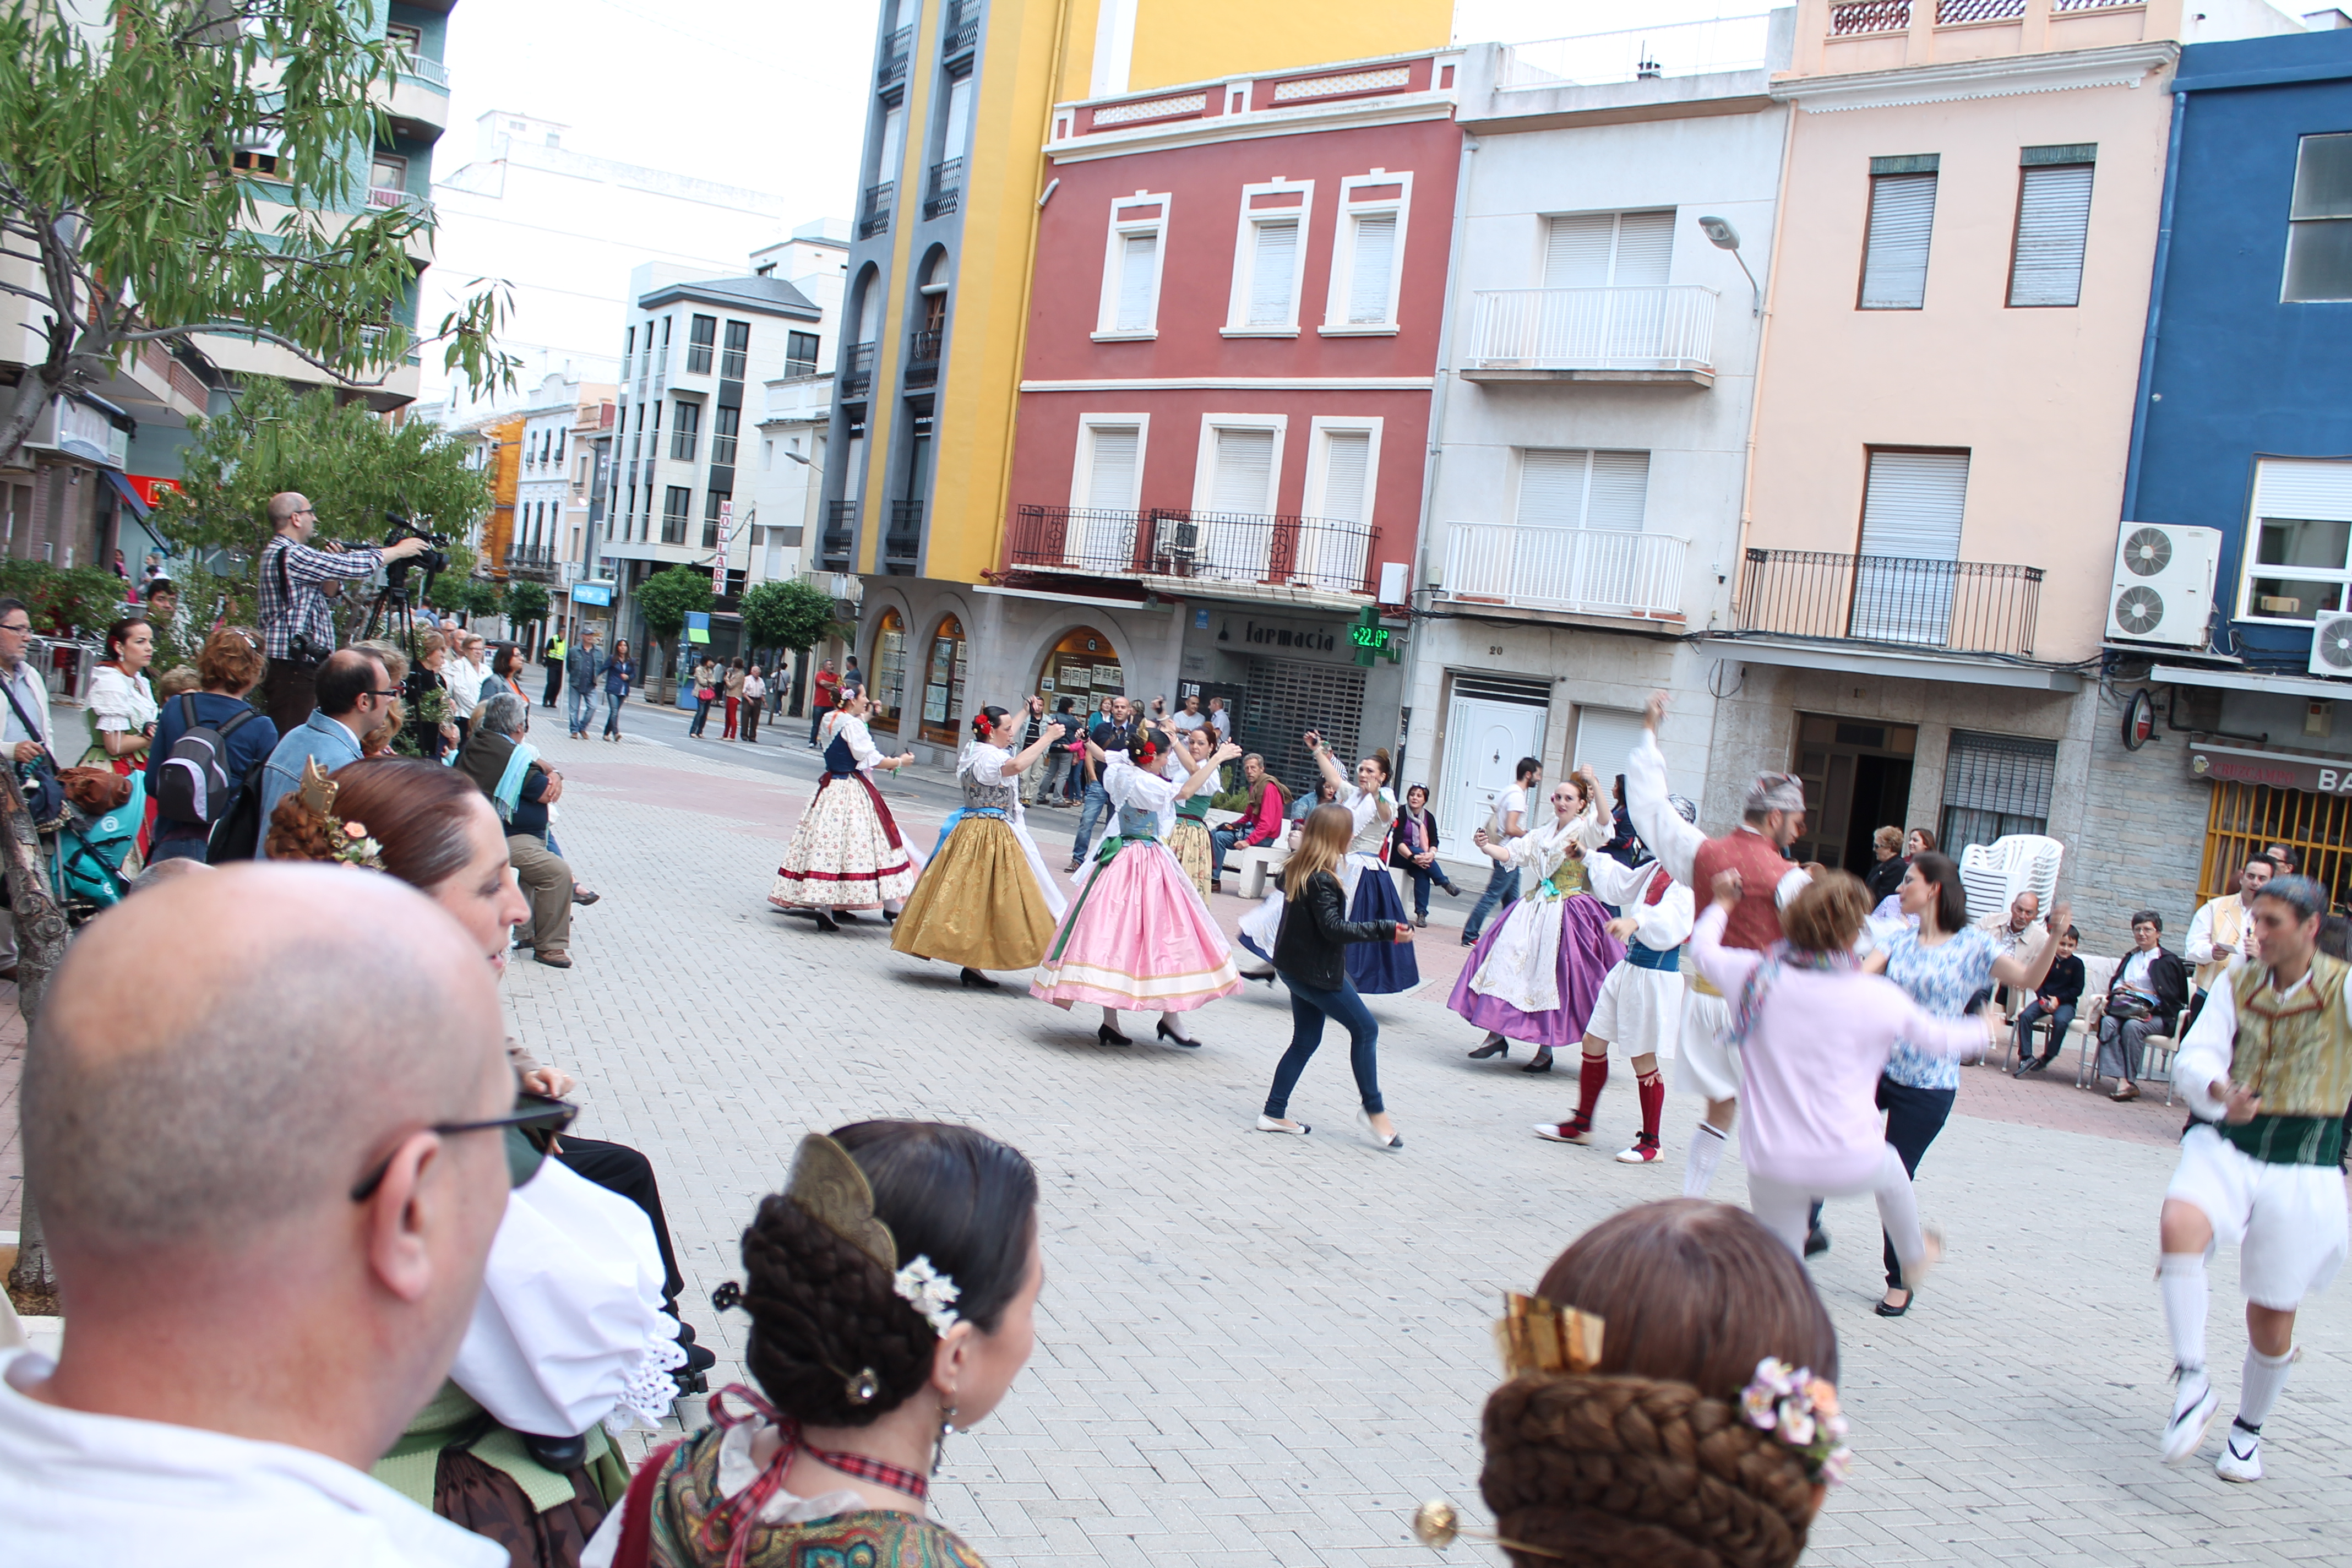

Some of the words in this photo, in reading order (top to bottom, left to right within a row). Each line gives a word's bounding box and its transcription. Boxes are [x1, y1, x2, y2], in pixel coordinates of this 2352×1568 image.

[715, 503, 731, 593] MOLLARO
[1088, 639, 1096, 651] G
[1245, 620, 1334, 651] farmacia
[1489, 646, 1502, 655] 20
[2213, 763, 2295, 784] CRUZCAMPO
